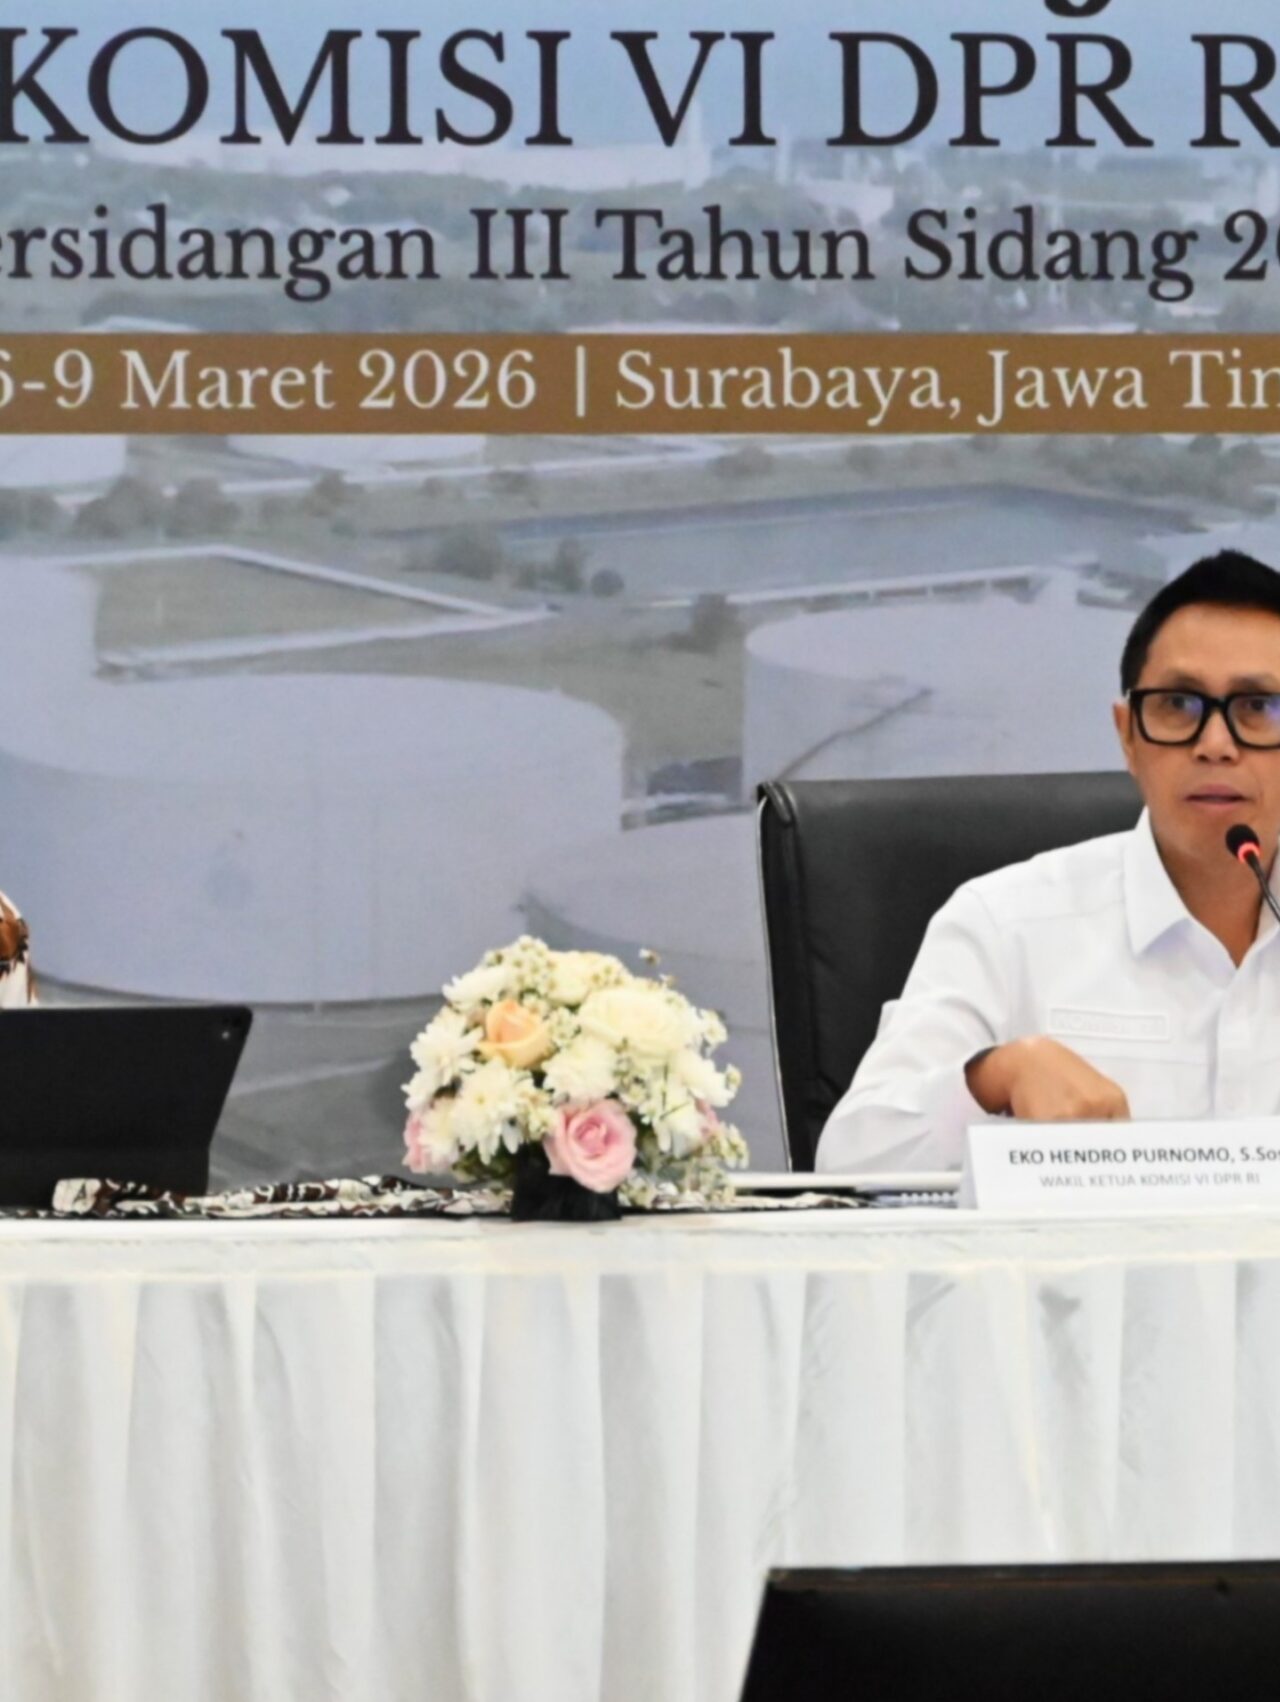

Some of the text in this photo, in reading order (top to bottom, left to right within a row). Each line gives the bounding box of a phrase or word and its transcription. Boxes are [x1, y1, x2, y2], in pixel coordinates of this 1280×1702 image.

[0, 27, 573, 146] KOMISI
[610, 31, 776, 147] VI
[826, 32, 1154, 148] DPR
[0, 203, 441, 303] rsidangan
[469, 208, 571, 280] III
[595, 204, 876, 282] Tahun
[905, 205, 1199, 303] Sidang
[120, 349, 334, 409] Maret
[359, 349, 536, 409] 2026
[616, 346, 962, 427] Surabaya,
[976, 350, 1147, 427] Jawa
[1008, 1150, 1045, 1164] EKO
[1050, 1149, 1127, 1163] HENDRO
[1132, 1147, 1235, 1163] PURNOMO,
[1040, 1172, 1261, 1187] WAKIL KETUA KOMISI VI DPR RI
